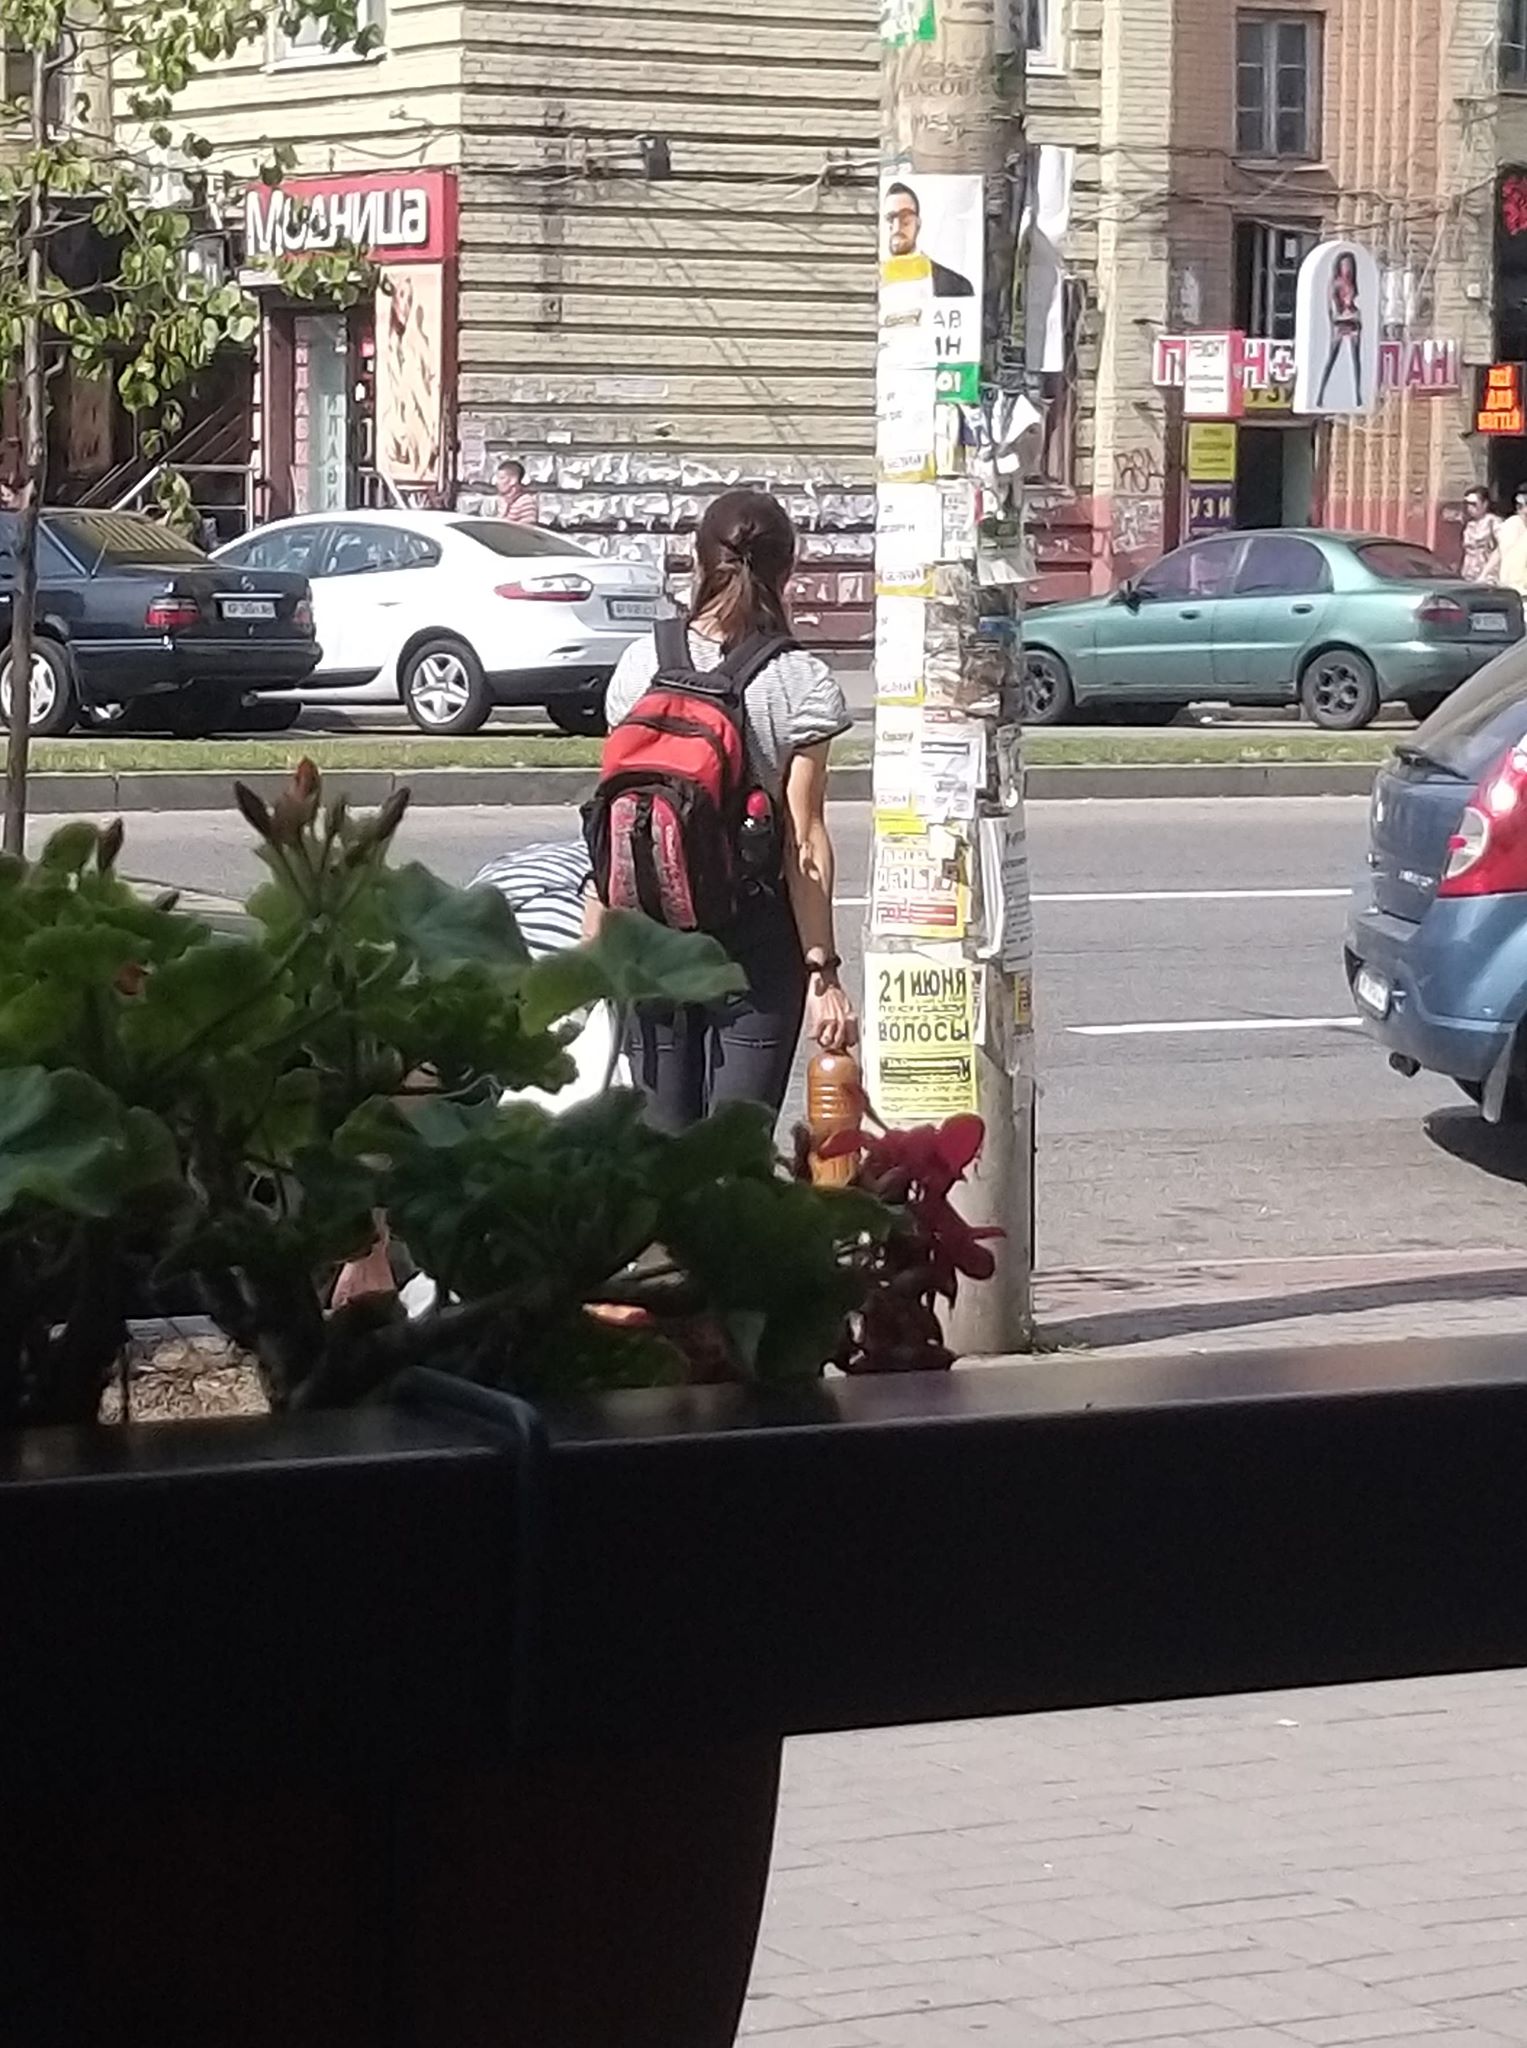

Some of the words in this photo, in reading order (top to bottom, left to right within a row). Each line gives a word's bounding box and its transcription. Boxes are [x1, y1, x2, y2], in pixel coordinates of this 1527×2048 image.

[1191, 496, 1231, 519] УЗИ
[879, 969, 905, 1004] 21
[878, 1019, 970, 1043] ВОЛОСЫ
